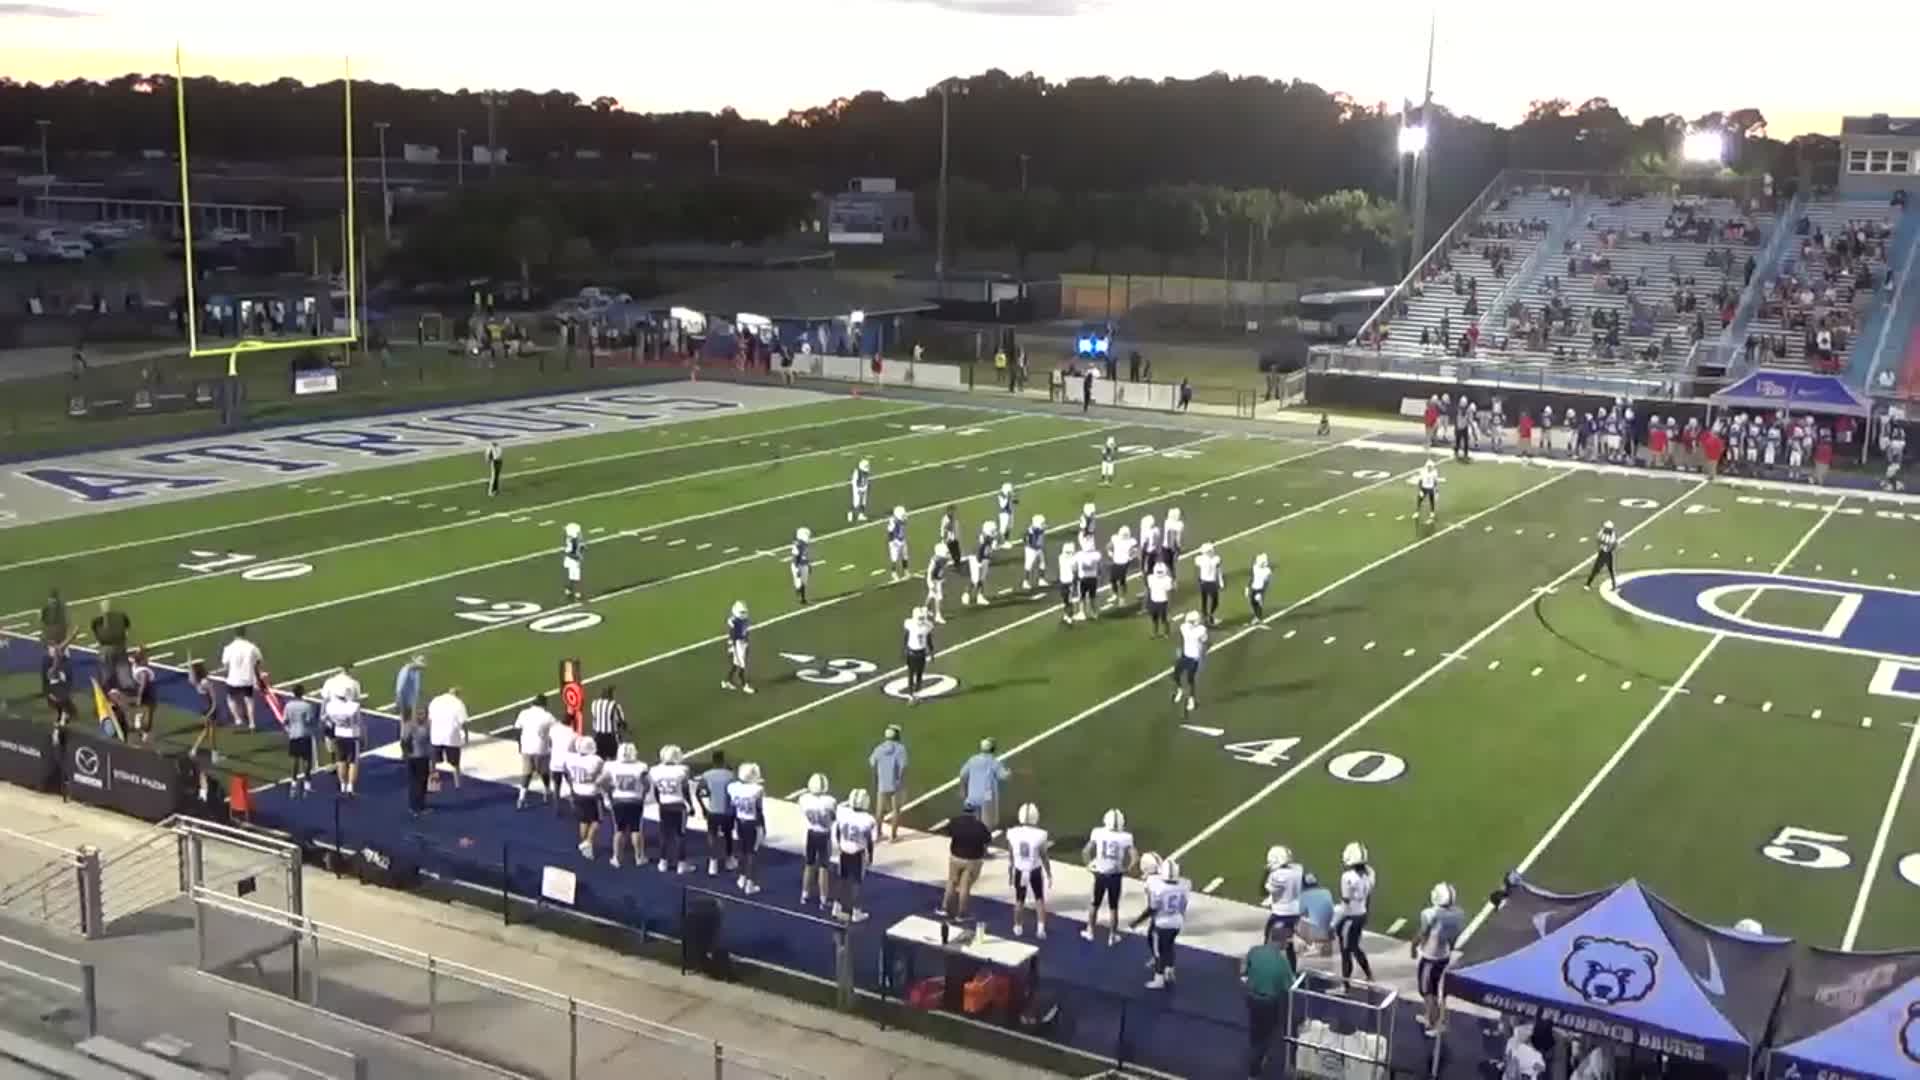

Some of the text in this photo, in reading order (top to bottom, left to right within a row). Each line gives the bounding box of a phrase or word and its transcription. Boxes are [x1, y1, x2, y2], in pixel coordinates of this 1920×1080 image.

[0, 391, 744, 522] ATRIOTS
[1224, 737, 1406, 782] 40
[1484, 992, 1538, 1017] SOUTH
[1541, 1006, 1634, 1043] FLORENCE
